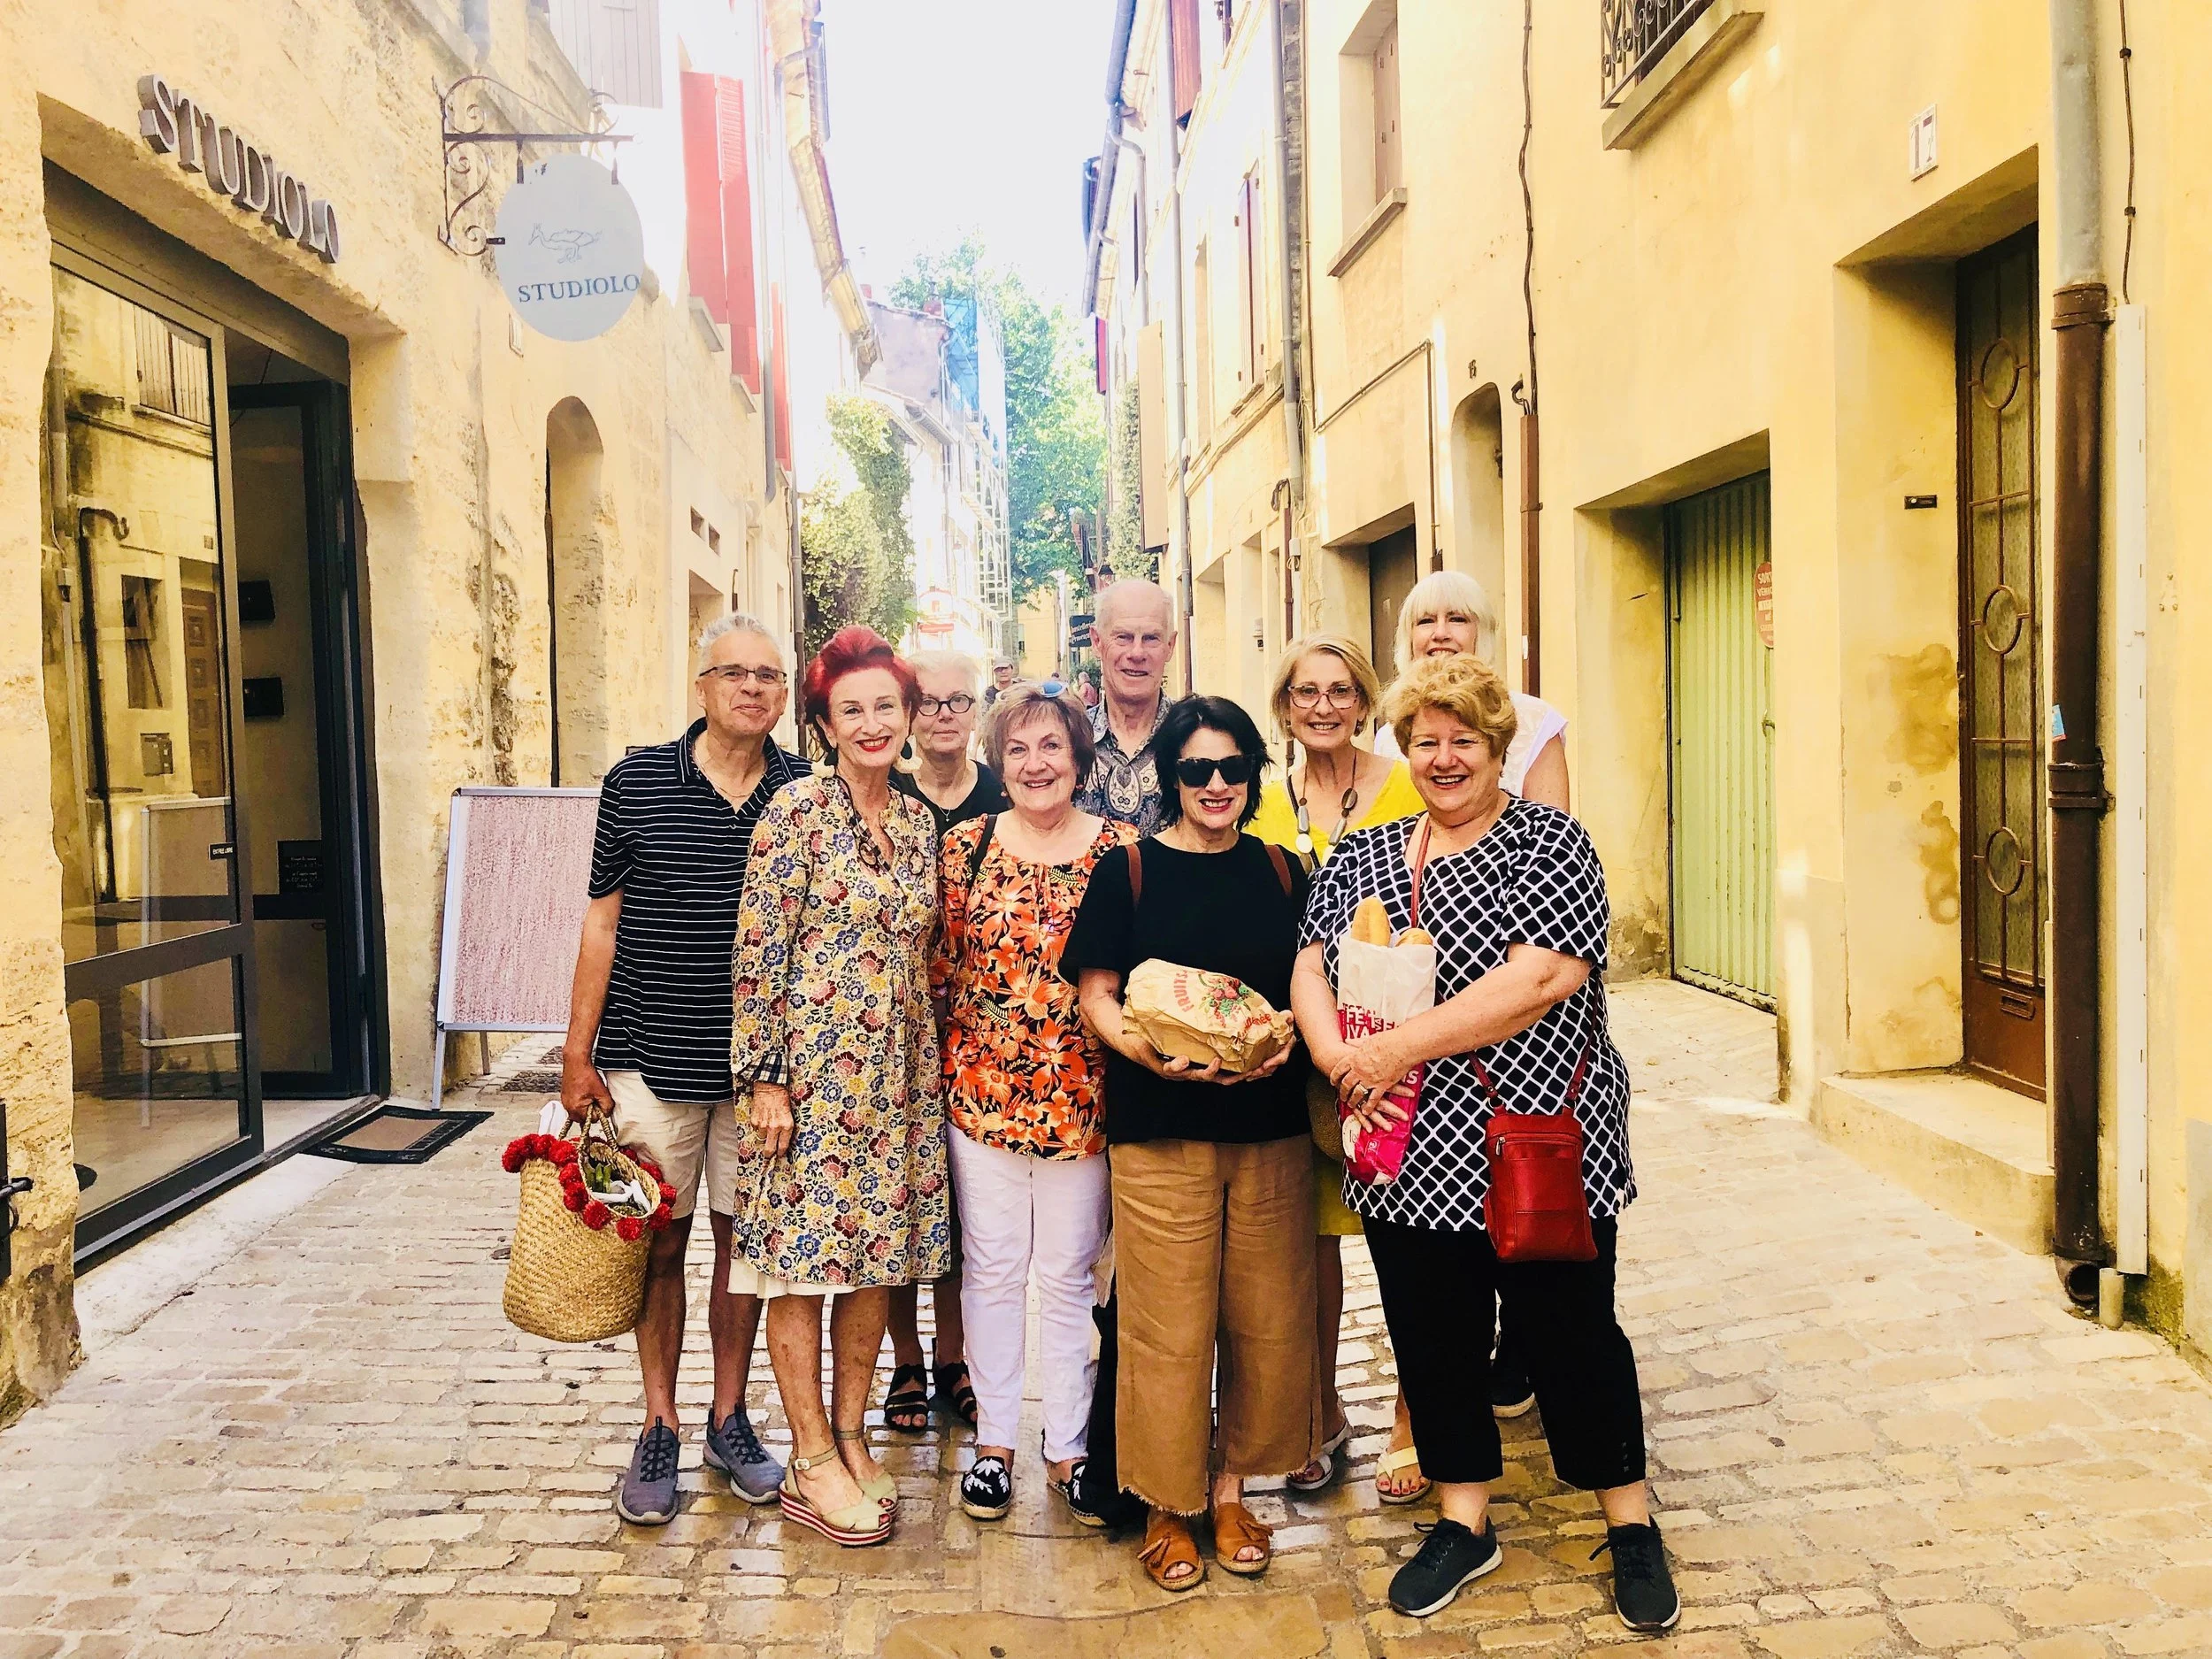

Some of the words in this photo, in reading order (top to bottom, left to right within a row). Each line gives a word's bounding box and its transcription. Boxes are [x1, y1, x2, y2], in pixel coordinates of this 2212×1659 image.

[137, 73, 340, 264] STUDIOLO
[1910, 114, 1934, 170] 17
[518, 274, 640, 303] STUDIOLO
